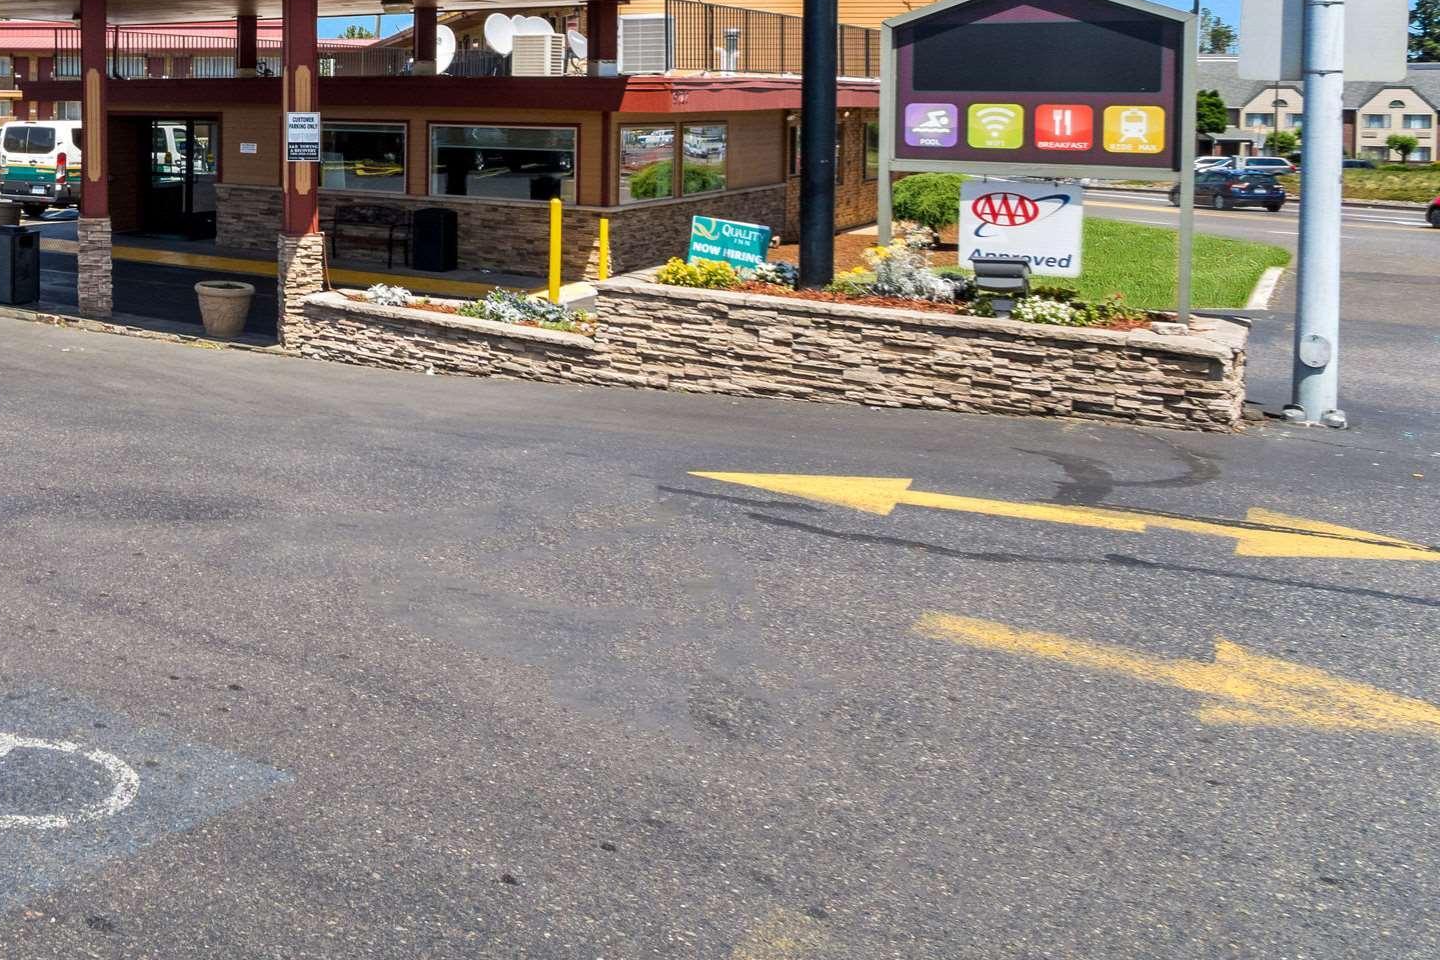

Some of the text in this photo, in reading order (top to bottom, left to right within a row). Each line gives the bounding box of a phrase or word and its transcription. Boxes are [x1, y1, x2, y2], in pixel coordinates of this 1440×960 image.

[919, 138, 941, 146] POOL
[1036, 141, 1089, 149] BREAKFAST
[976, 193, 1036, 226] AAA
[722, 224, 765, 241] QUALITY
[733, 238, 751, 246] INN
[692, 242, 763, 263] NOW HIRING
